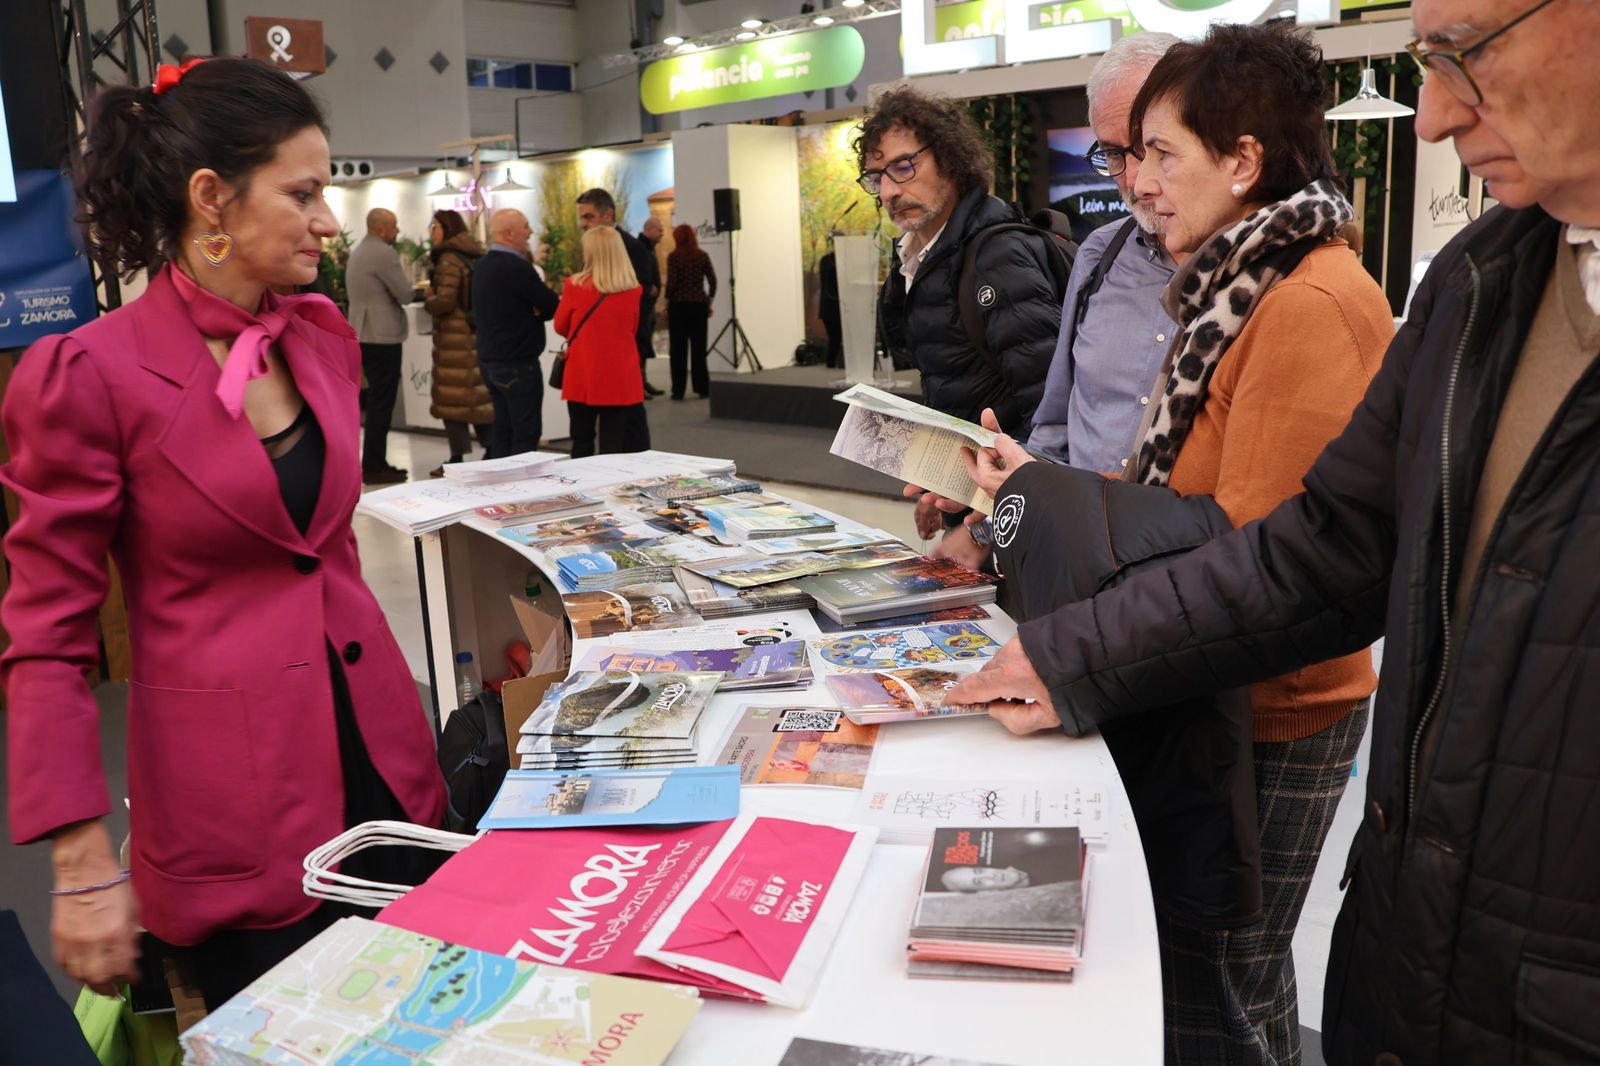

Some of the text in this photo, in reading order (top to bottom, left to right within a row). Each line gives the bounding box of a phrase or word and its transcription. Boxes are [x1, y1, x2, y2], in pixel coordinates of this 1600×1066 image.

[1079, 196, 1106, 215] León
[20, 308, 77, 326] ZAMORA
[21, 295, 71, 309] TURISMO
[503, 843, 664, 966] ZAMORA
[781, 880, 824, 924] ZAMORA
[581, 1013, 645, 1066] MORA
